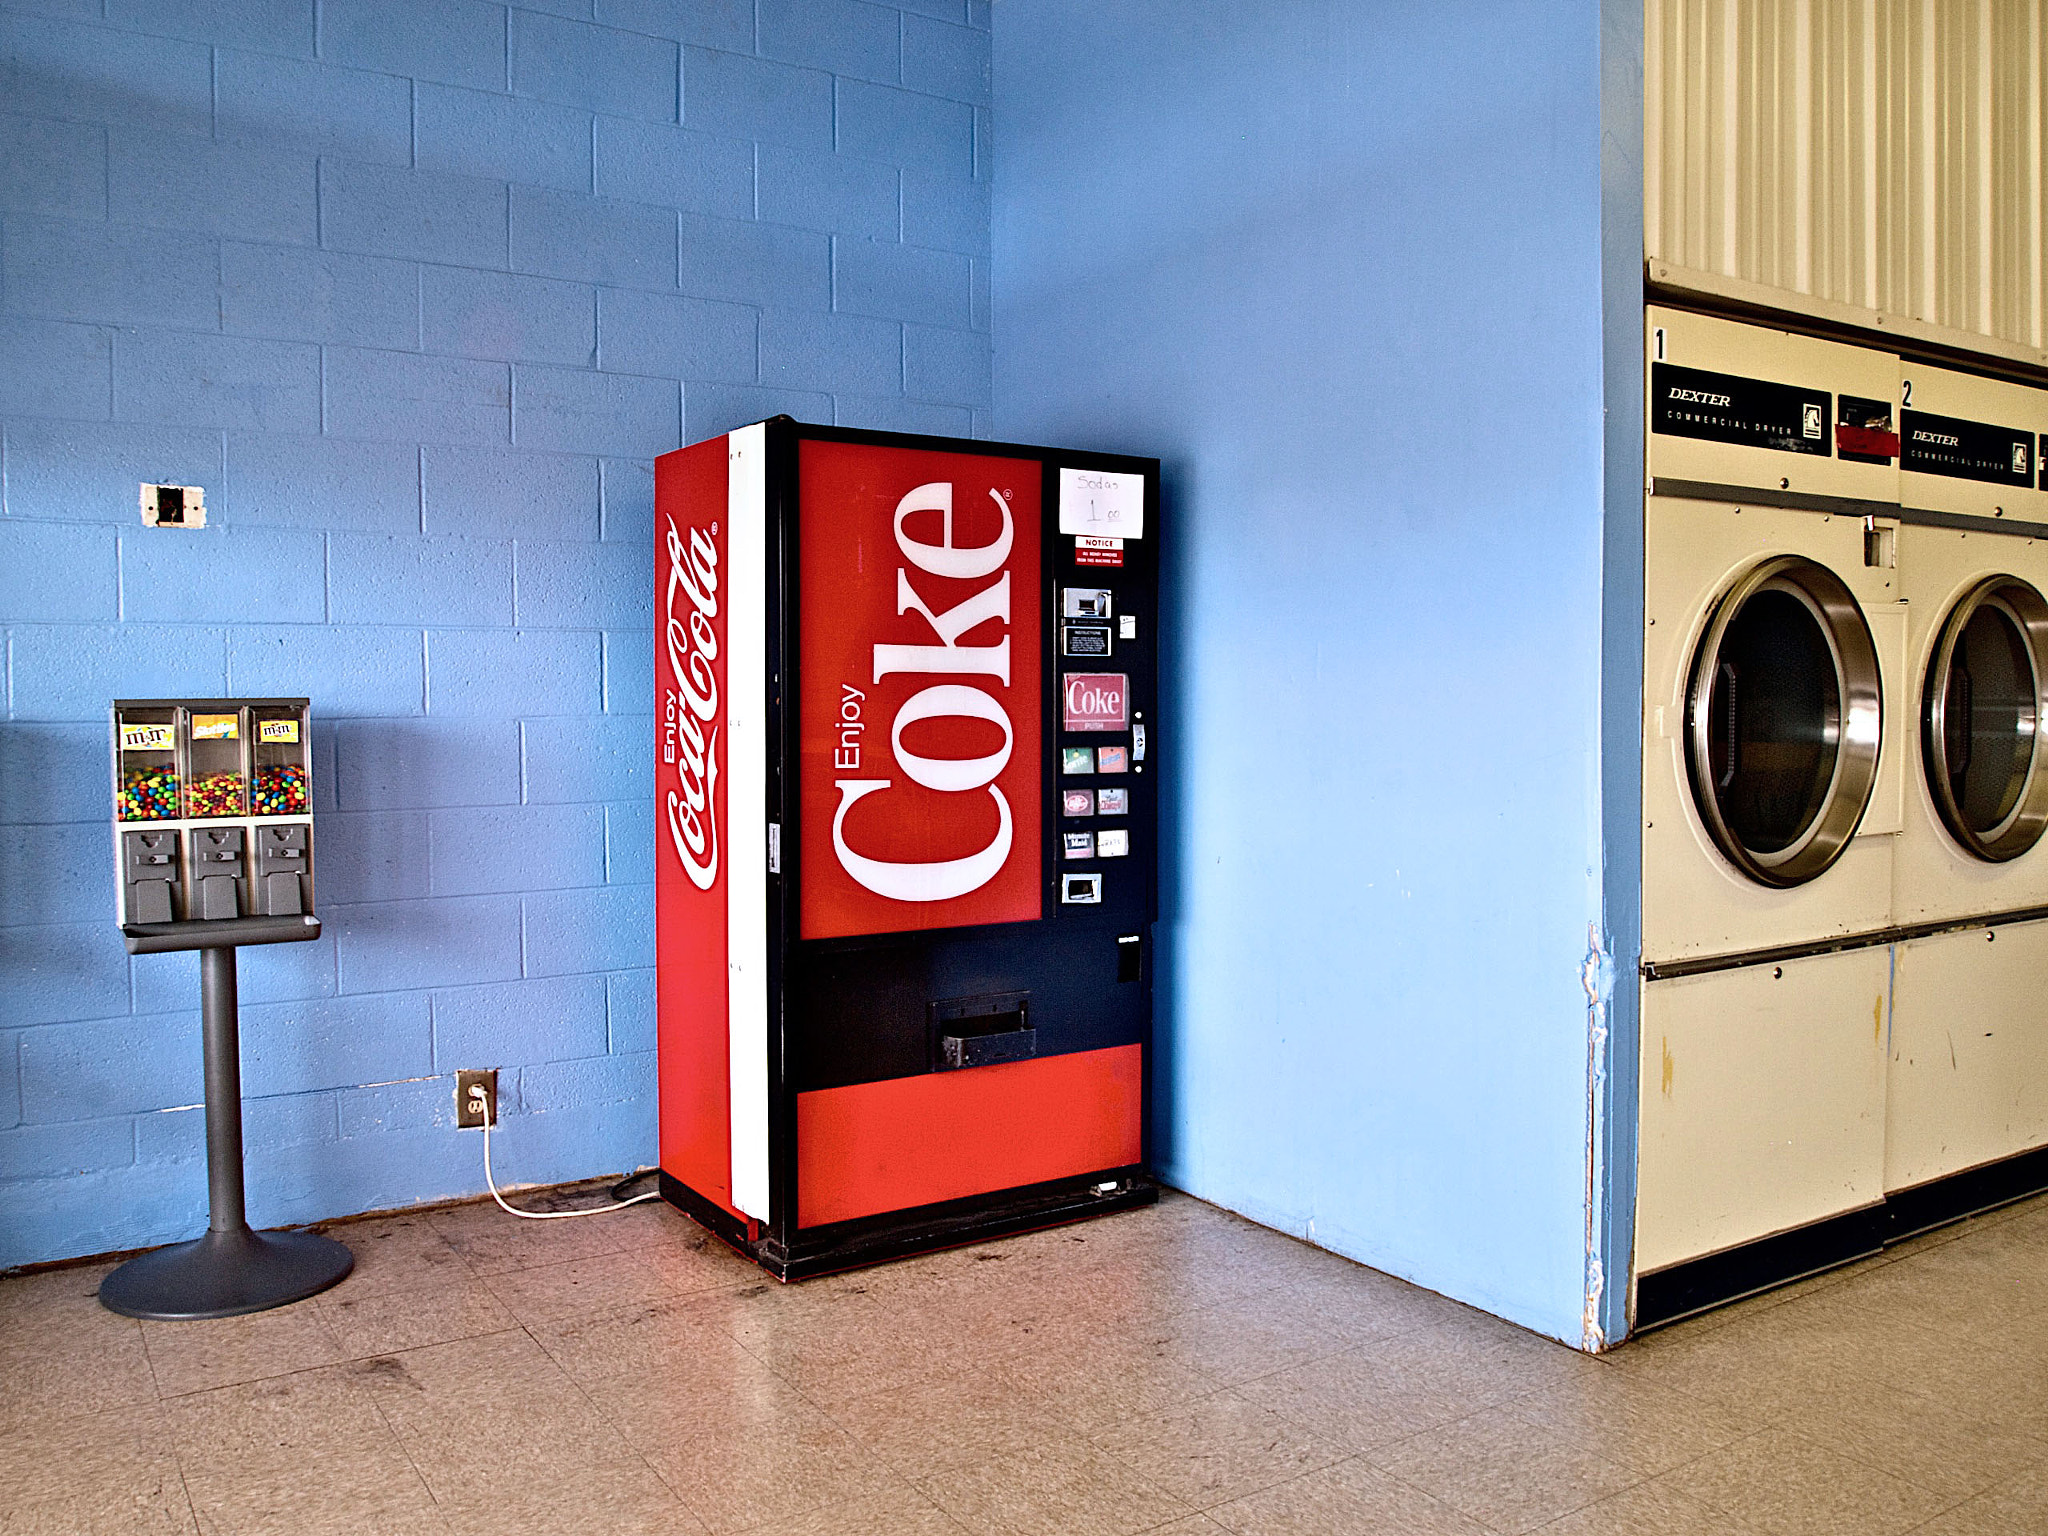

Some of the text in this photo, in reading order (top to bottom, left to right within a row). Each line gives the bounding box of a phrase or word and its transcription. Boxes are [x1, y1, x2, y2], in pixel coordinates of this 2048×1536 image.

[1655, 328, 1664, 360] 1
[1668, 387, 1731, 407] DEXTER
[1902, 380, 1912, 407] 2
[1667, 410, 1792, 435] COMMERCIAL DRYER
[1912, 430, 1959, 447] DEXTER
[1911, 450, 2004, 470] COMMERCIAL DRYER
[1077, 475, 1118, 489] Sodas
[1085, 539, 1113, 547] NOTICE
[667, 512, 719, 890] Coca-Cola
[833, 482, 1014, 902] Coke
[1068, 680, 1120, 715] Coke
[664, 688, 677, 765] Enjoy
[835, 683, 865, 770] Enjoy
[1084, 722, 1104, 730] PUSH
